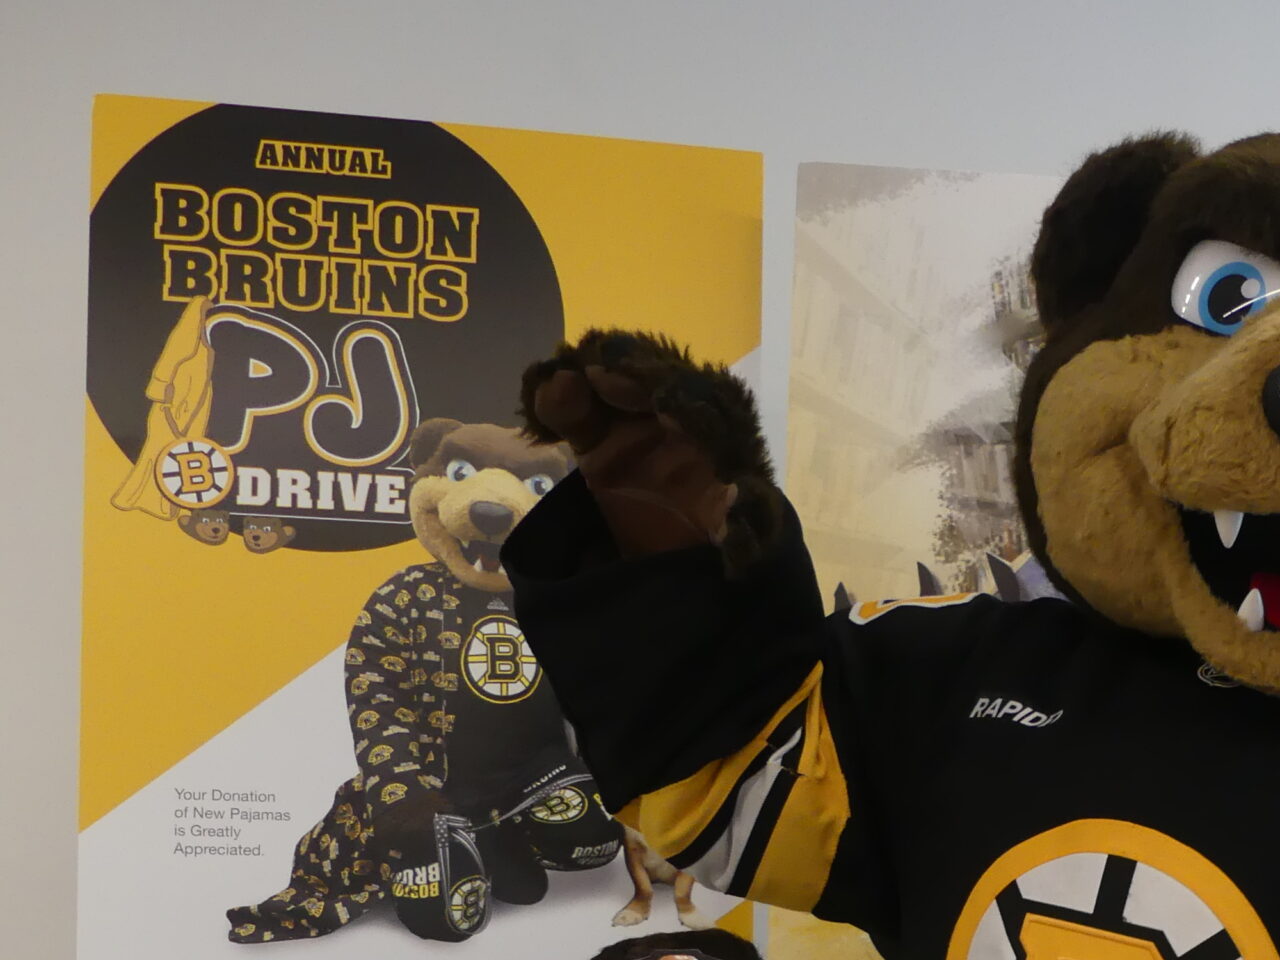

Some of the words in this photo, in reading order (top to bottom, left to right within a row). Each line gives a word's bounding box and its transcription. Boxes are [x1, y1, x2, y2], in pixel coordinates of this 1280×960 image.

[256, 139, 391, 179] ANNUAL
[155, 183, 479, 263] BOSTON
[162, 245, 468, 322] BRUINS
[205, 314, 411, 467] PJ
[236, 466, 406, 514] DRIVE
[174, 787, 207, 801] Your
[212, 789, 276, 802] Donation
[174, 806, 189, 819] of
[193, 807, 225, 819] New
[230, 807, 291, 823] Pajamas
[173, 842, 265, 858] Appreciated.
[174, 824, 186, 837] is
[190, 824, 241, 840] Greatly
